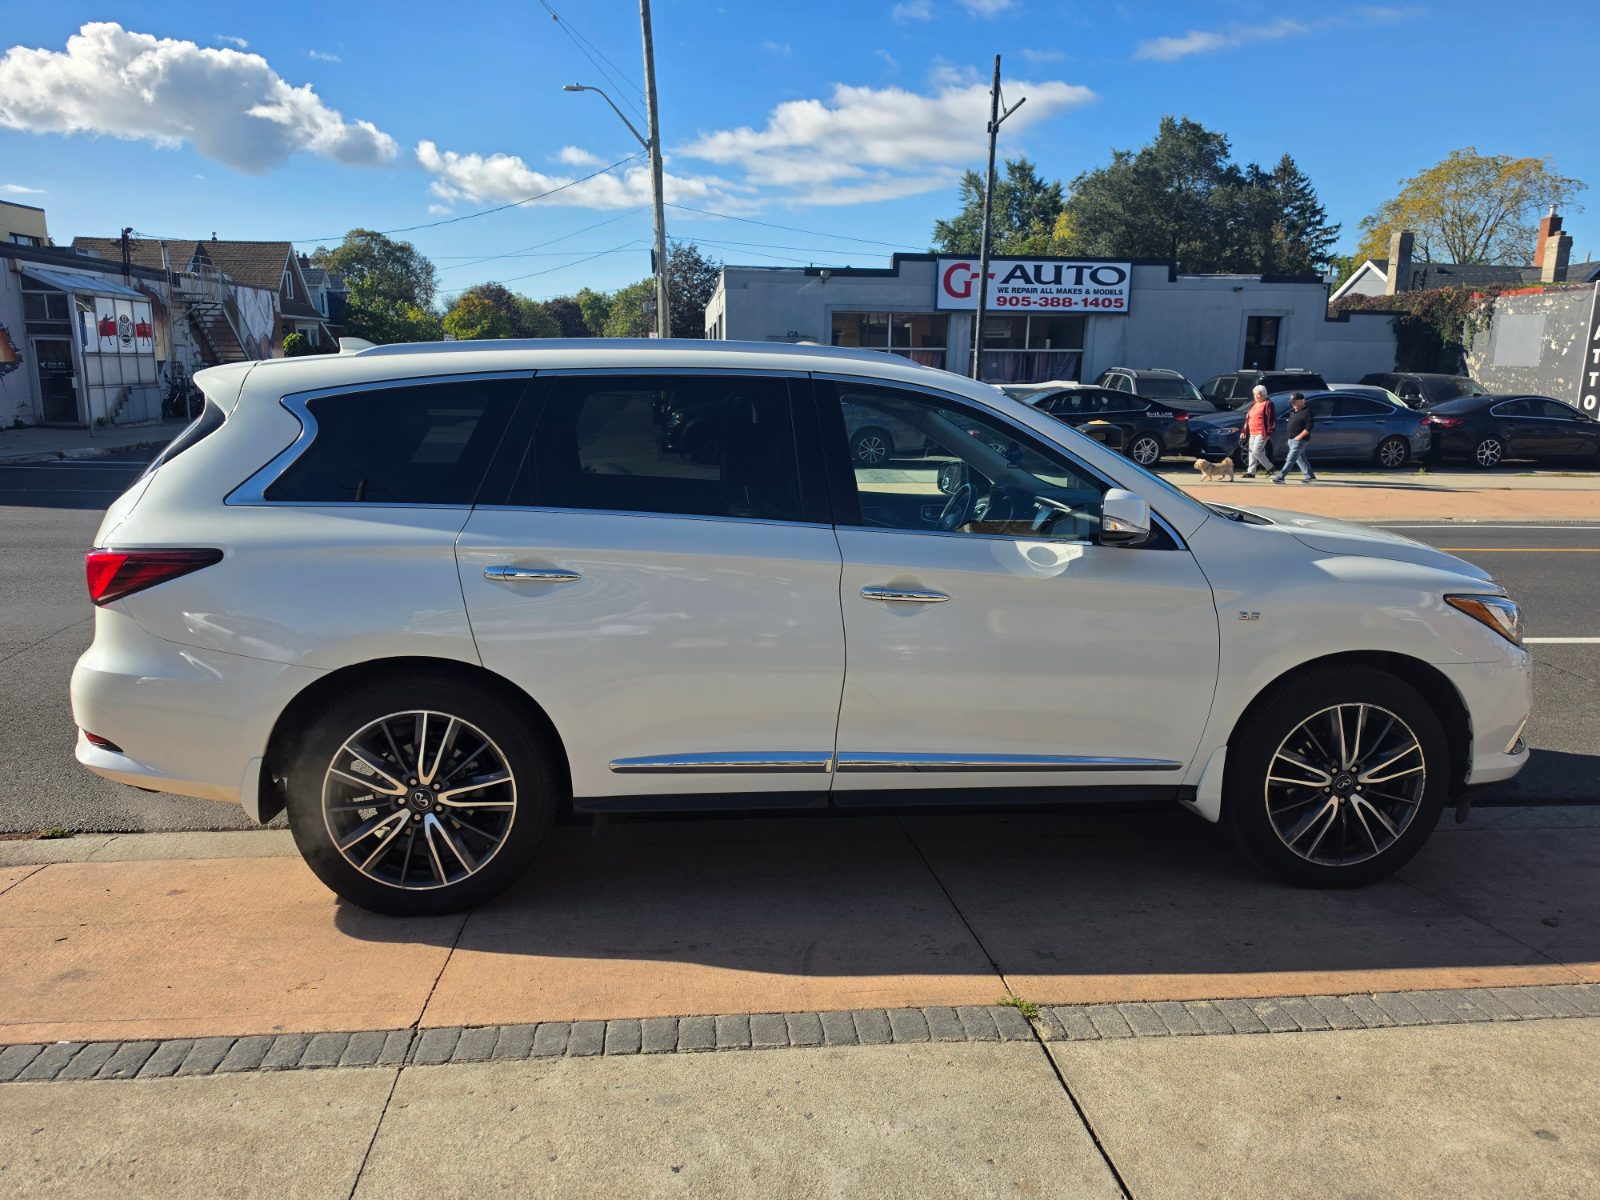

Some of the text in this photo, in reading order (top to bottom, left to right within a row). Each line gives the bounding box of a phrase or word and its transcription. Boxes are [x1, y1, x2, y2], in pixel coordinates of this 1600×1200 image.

[999, 264, 1127, 286] AUTO
[1093, 288, 1124, 296] MODELS
[996, 295, 1124, 309] 905-388-1405
